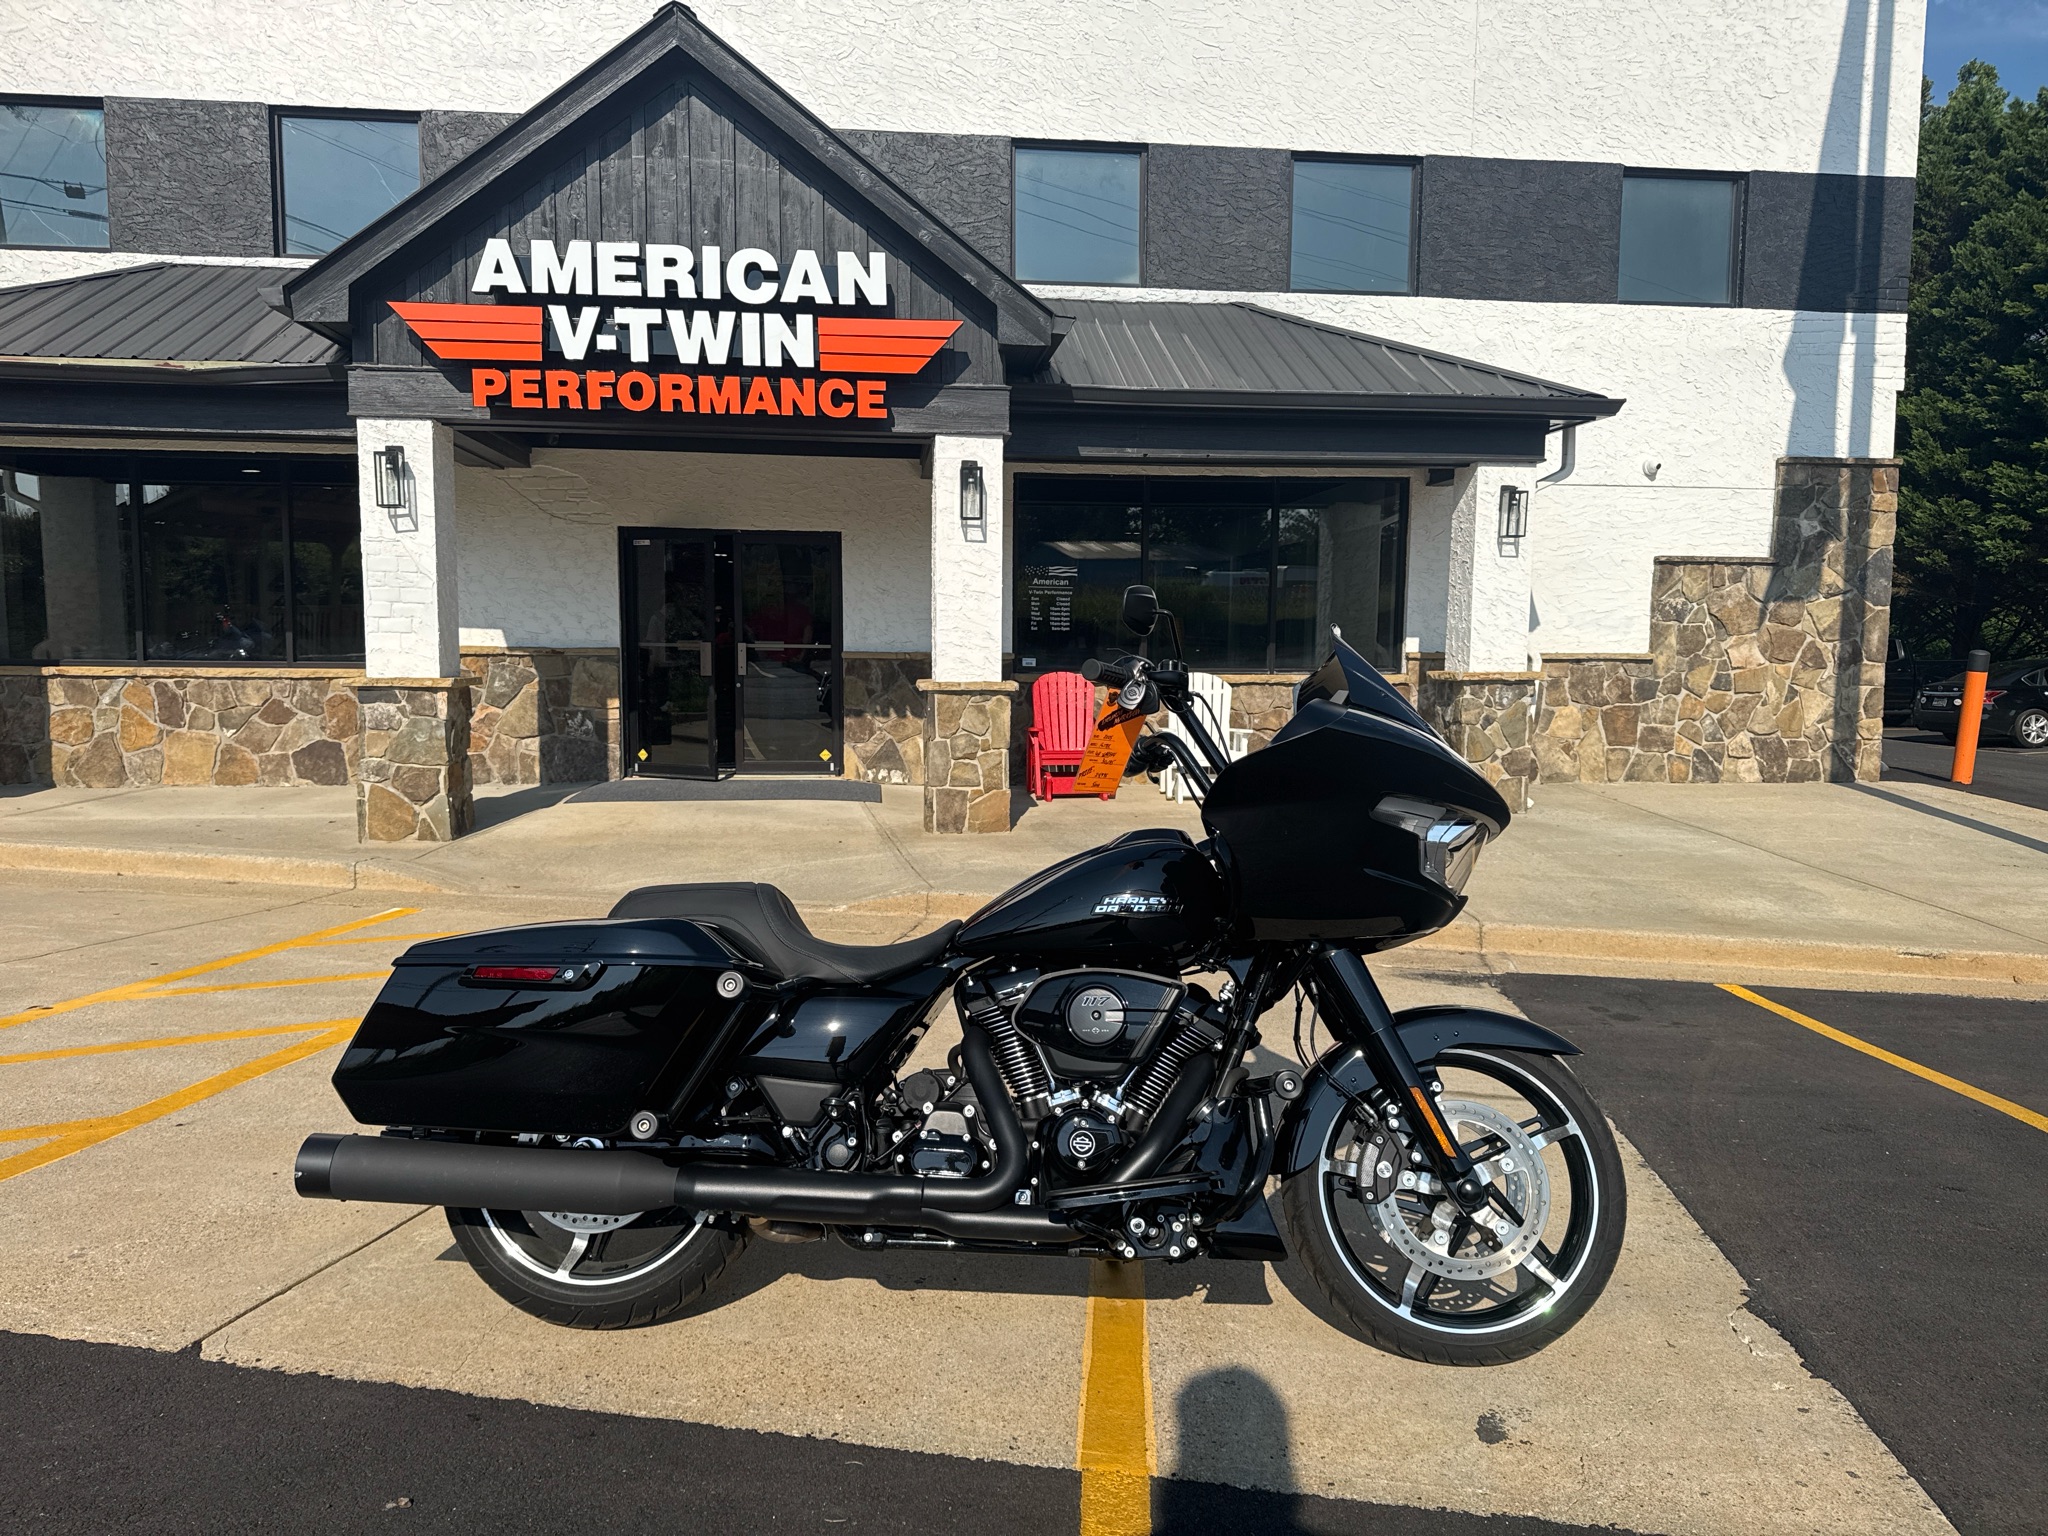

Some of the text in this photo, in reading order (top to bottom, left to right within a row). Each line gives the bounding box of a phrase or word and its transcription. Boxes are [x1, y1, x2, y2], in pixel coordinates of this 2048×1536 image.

[471, 238, 888, 305] AMERICAN
[547, 304, 815, 368] V-TWIN
[472, 368, 888, 419] PERFORMANCE
[1032, 577, 1069, 586] American
[1103, 896, 1168, 904] HARLEY
[1081, 996, 1111, 1006] 117
